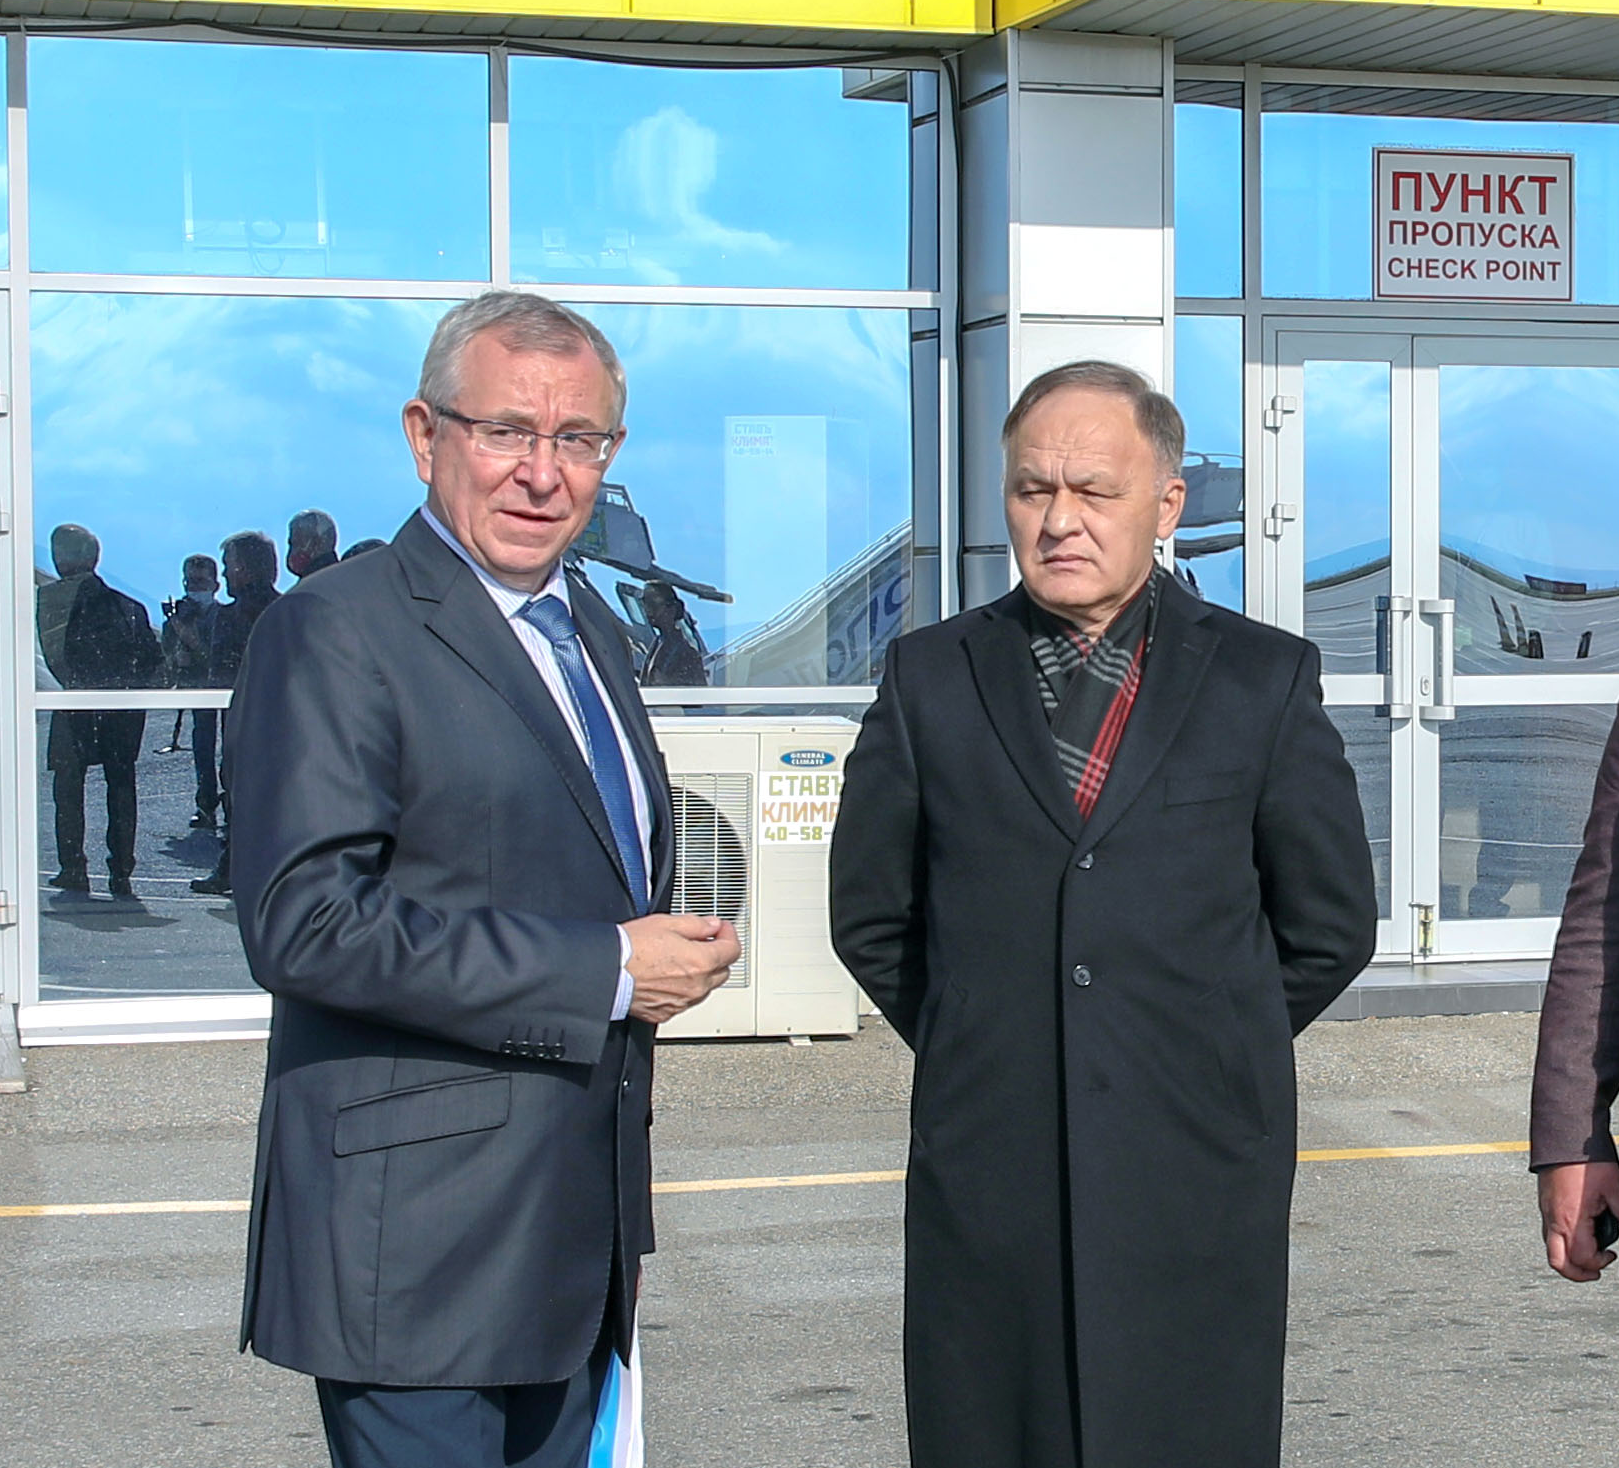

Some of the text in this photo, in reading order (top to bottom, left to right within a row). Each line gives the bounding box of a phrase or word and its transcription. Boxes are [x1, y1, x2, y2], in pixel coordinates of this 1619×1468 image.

[1391, 171, 1558, 216] ПУНКТ
[1389, 220, 1561, 249] ПРОПУСКА
[1387, 257, 1561, 282] CHECK POINT
[764, 826, 832, 841] 40-58-
